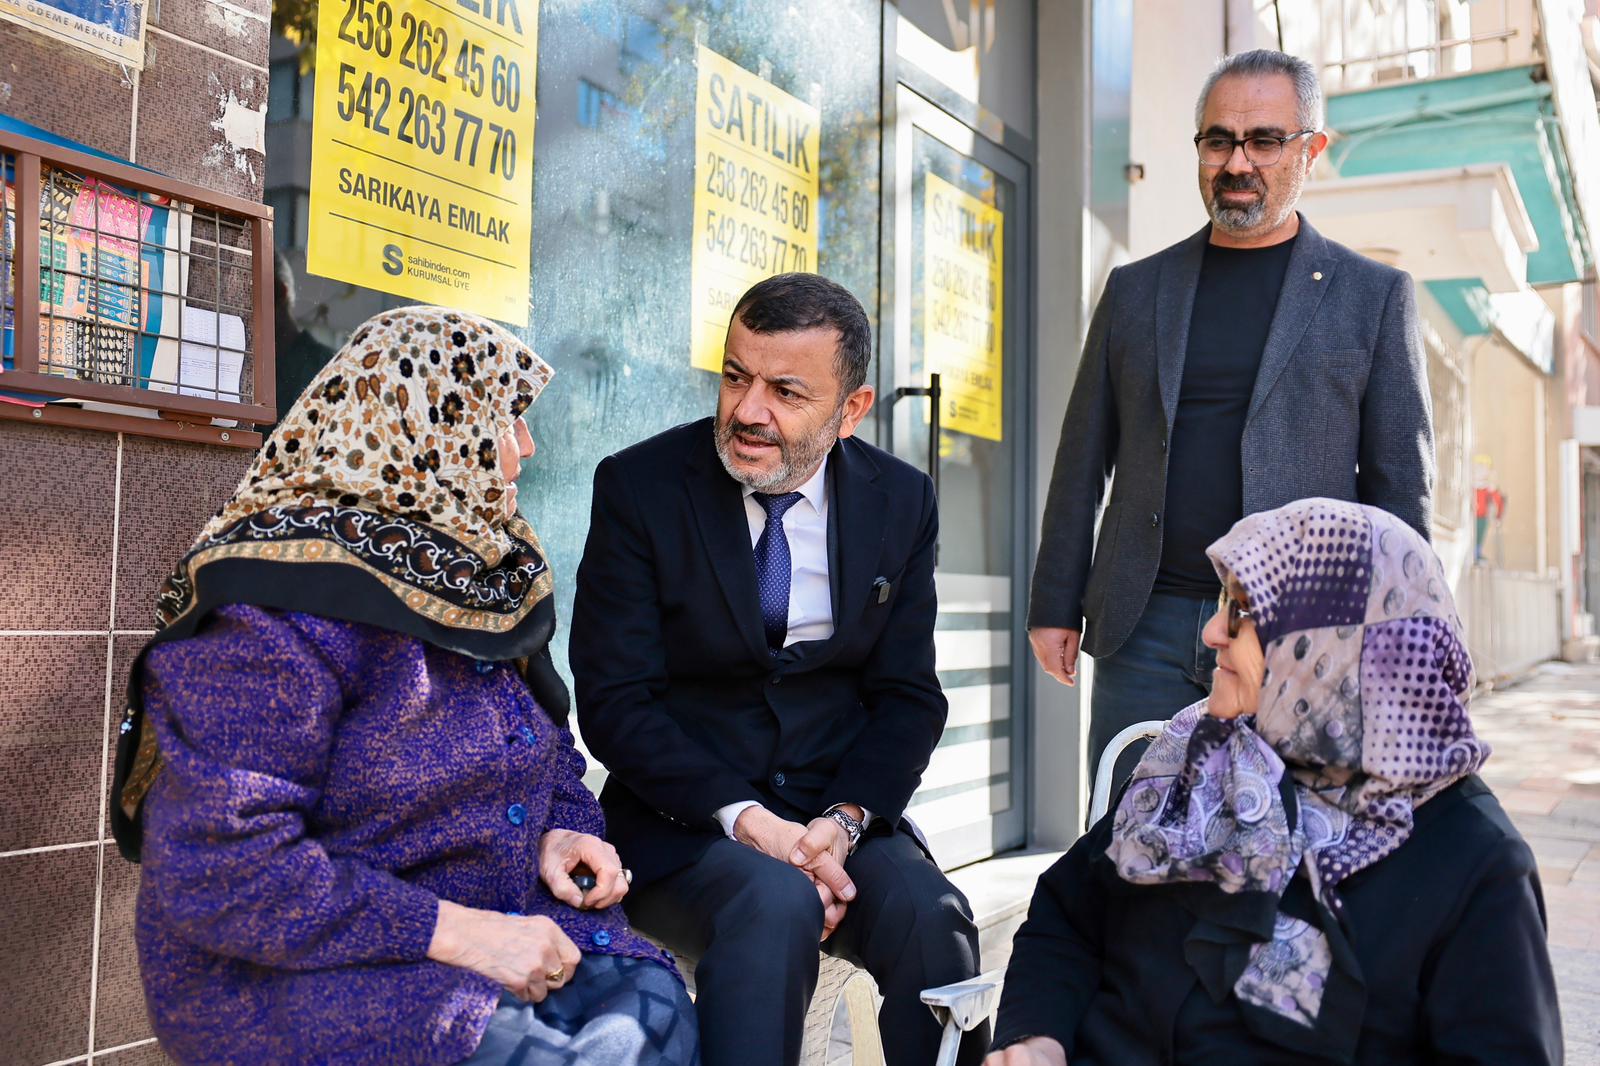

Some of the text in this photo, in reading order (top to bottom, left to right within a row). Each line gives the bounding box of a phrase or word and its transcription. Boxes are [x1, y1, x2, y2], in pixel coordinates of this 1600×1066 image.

[27, 2, 123, 47] ÖDEME MERKEZİ
[338, 0, 393, 58] 258
[399, 12, 448, 83] 262
[454, 39, 485, 97] 45
[491, 55, 520, 112] 60
[337, 62, 516, 180] 542 263 77 70
[707, 73, 810, 173] SATILIK
[338, 167, 510, 244] SARIKAYA EMLAK
[707, 151, 809, 233] 258 262 45 60
[382, 243, 470, 279] S sahibinden.com
[407, 267, 470, 291] KURUMSAL ÜYE
[706, 209, 807, 274] 542 263 77 70
